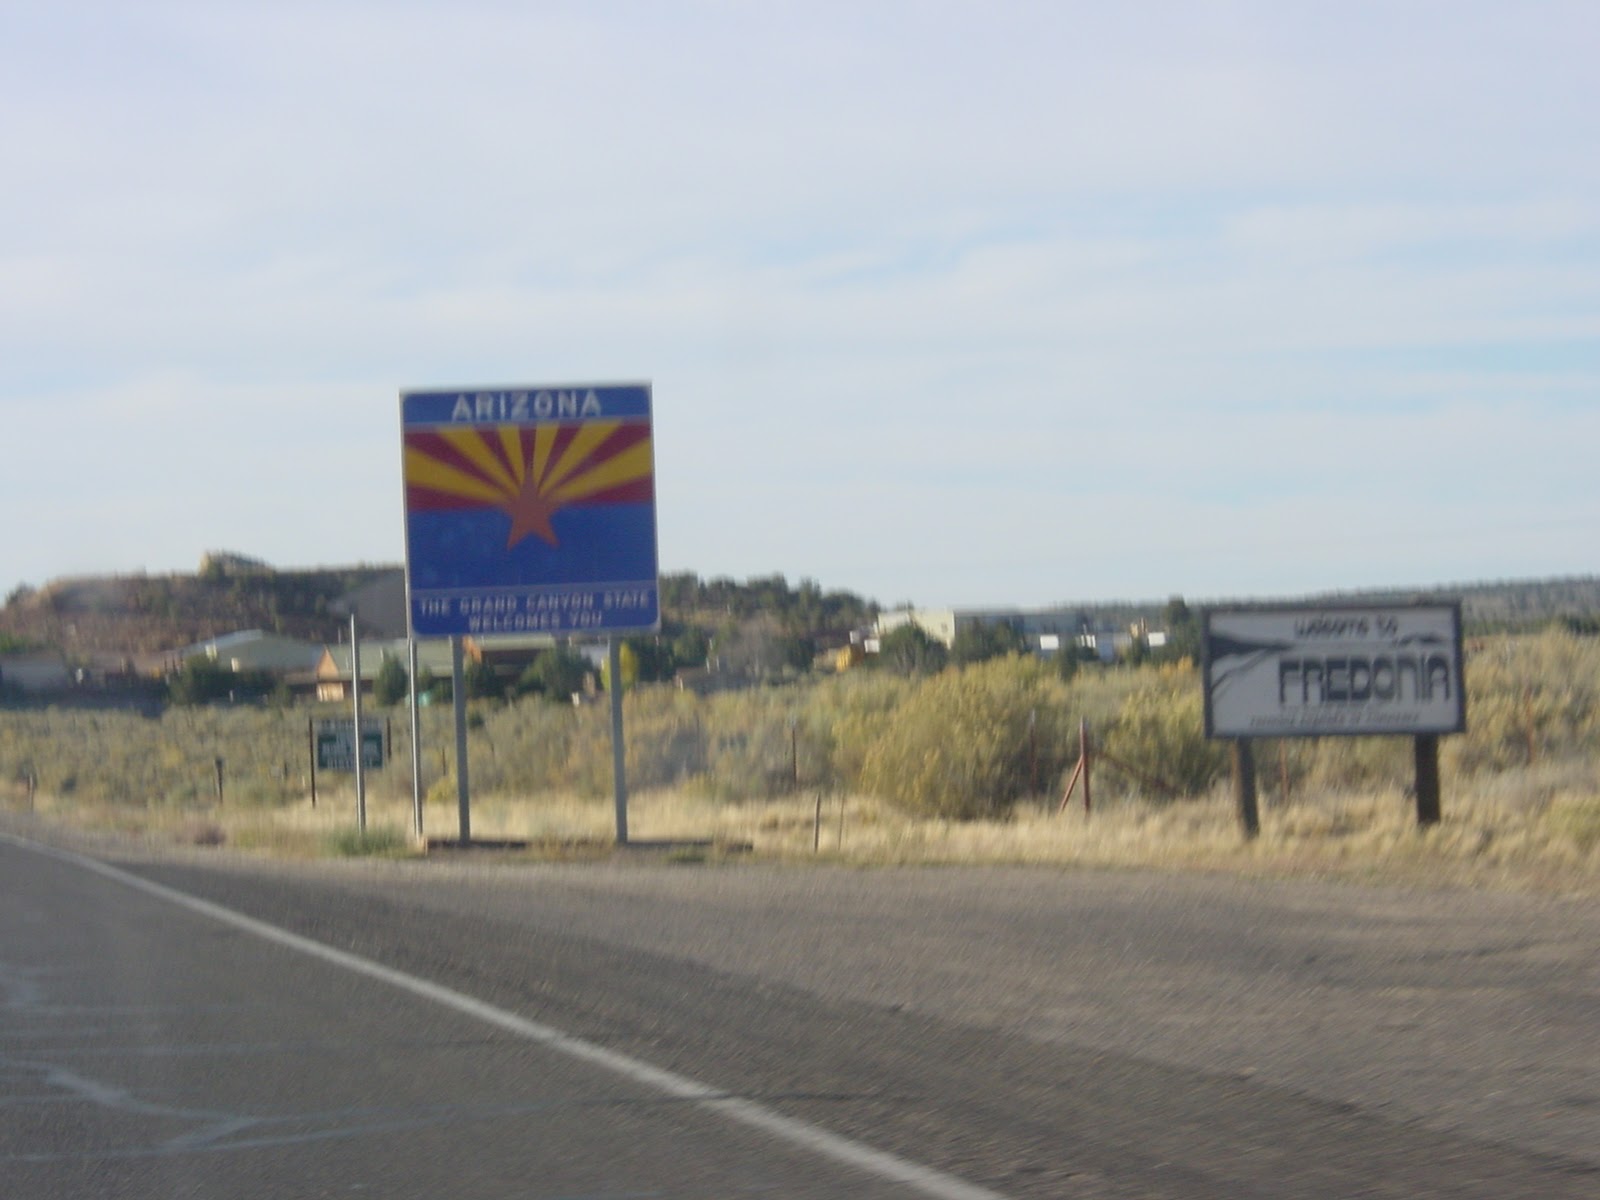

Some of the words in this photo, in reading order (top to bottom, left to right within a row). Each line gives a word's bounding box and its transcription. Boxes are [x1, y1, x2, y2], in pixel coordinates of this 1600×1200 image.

[452, 390, 602, 421] ARIZONA
[421, 597, 449, 616] THE
[459, 595, 516, 614] GRAND
[525, 592, 593, 611] CANYON
[603, 590, 649, 609] STATE
[468, 613, 561, 631] WELCOMES
[570, 610, 602, 628] YOU
[1278, 656, 1450, 704] FREDONIA
